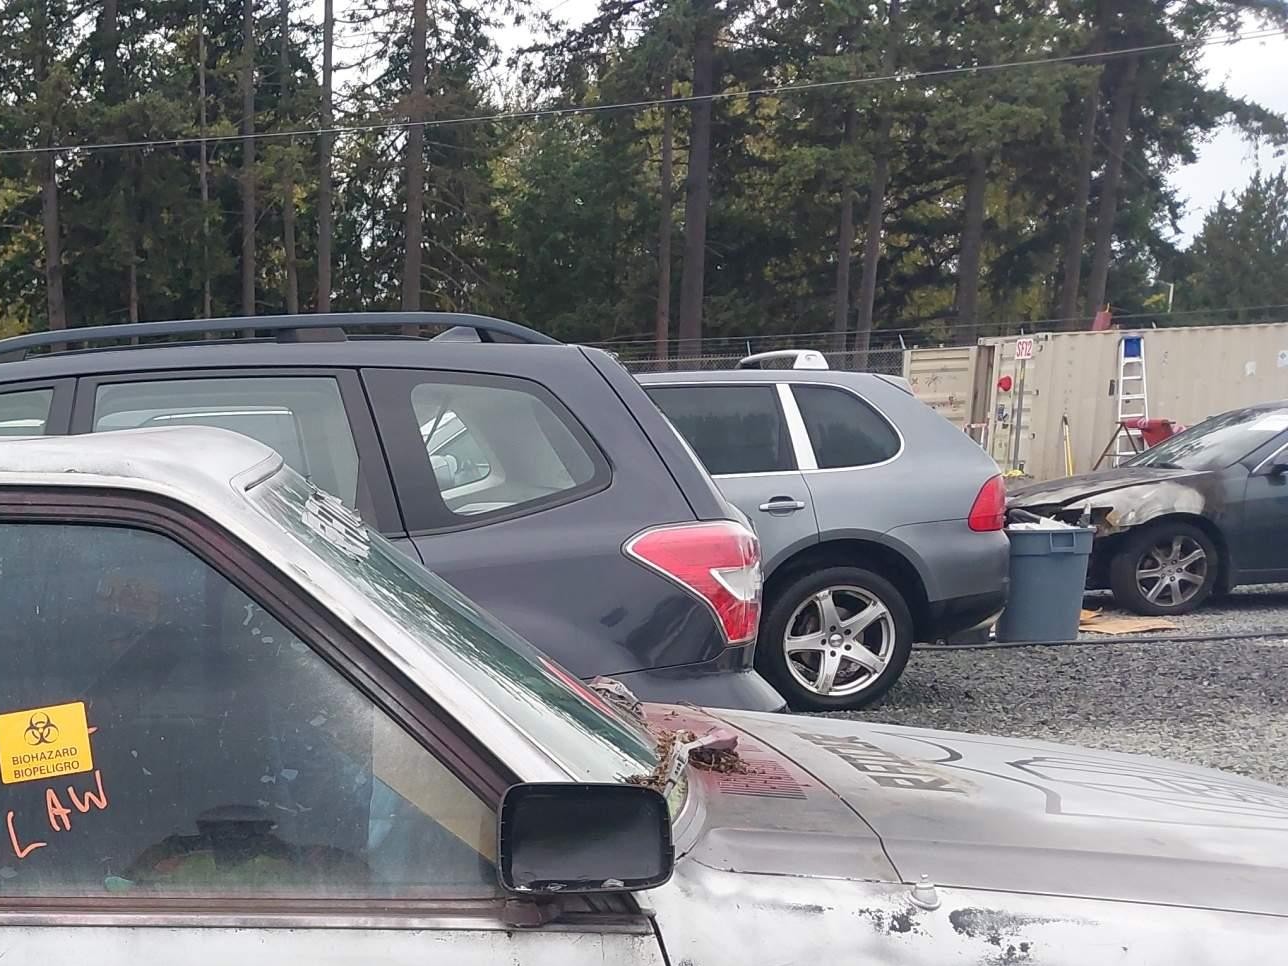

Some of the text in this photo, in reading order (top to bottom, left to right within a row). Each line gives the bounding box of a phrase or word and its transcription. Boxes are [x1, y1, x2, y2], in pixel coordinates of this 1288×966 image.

[11, 746, 78, 766] BIOHAZARD
[13, 760, 81, 779] BIOPELIGRO
[7, 770, 107, 858] LAW
